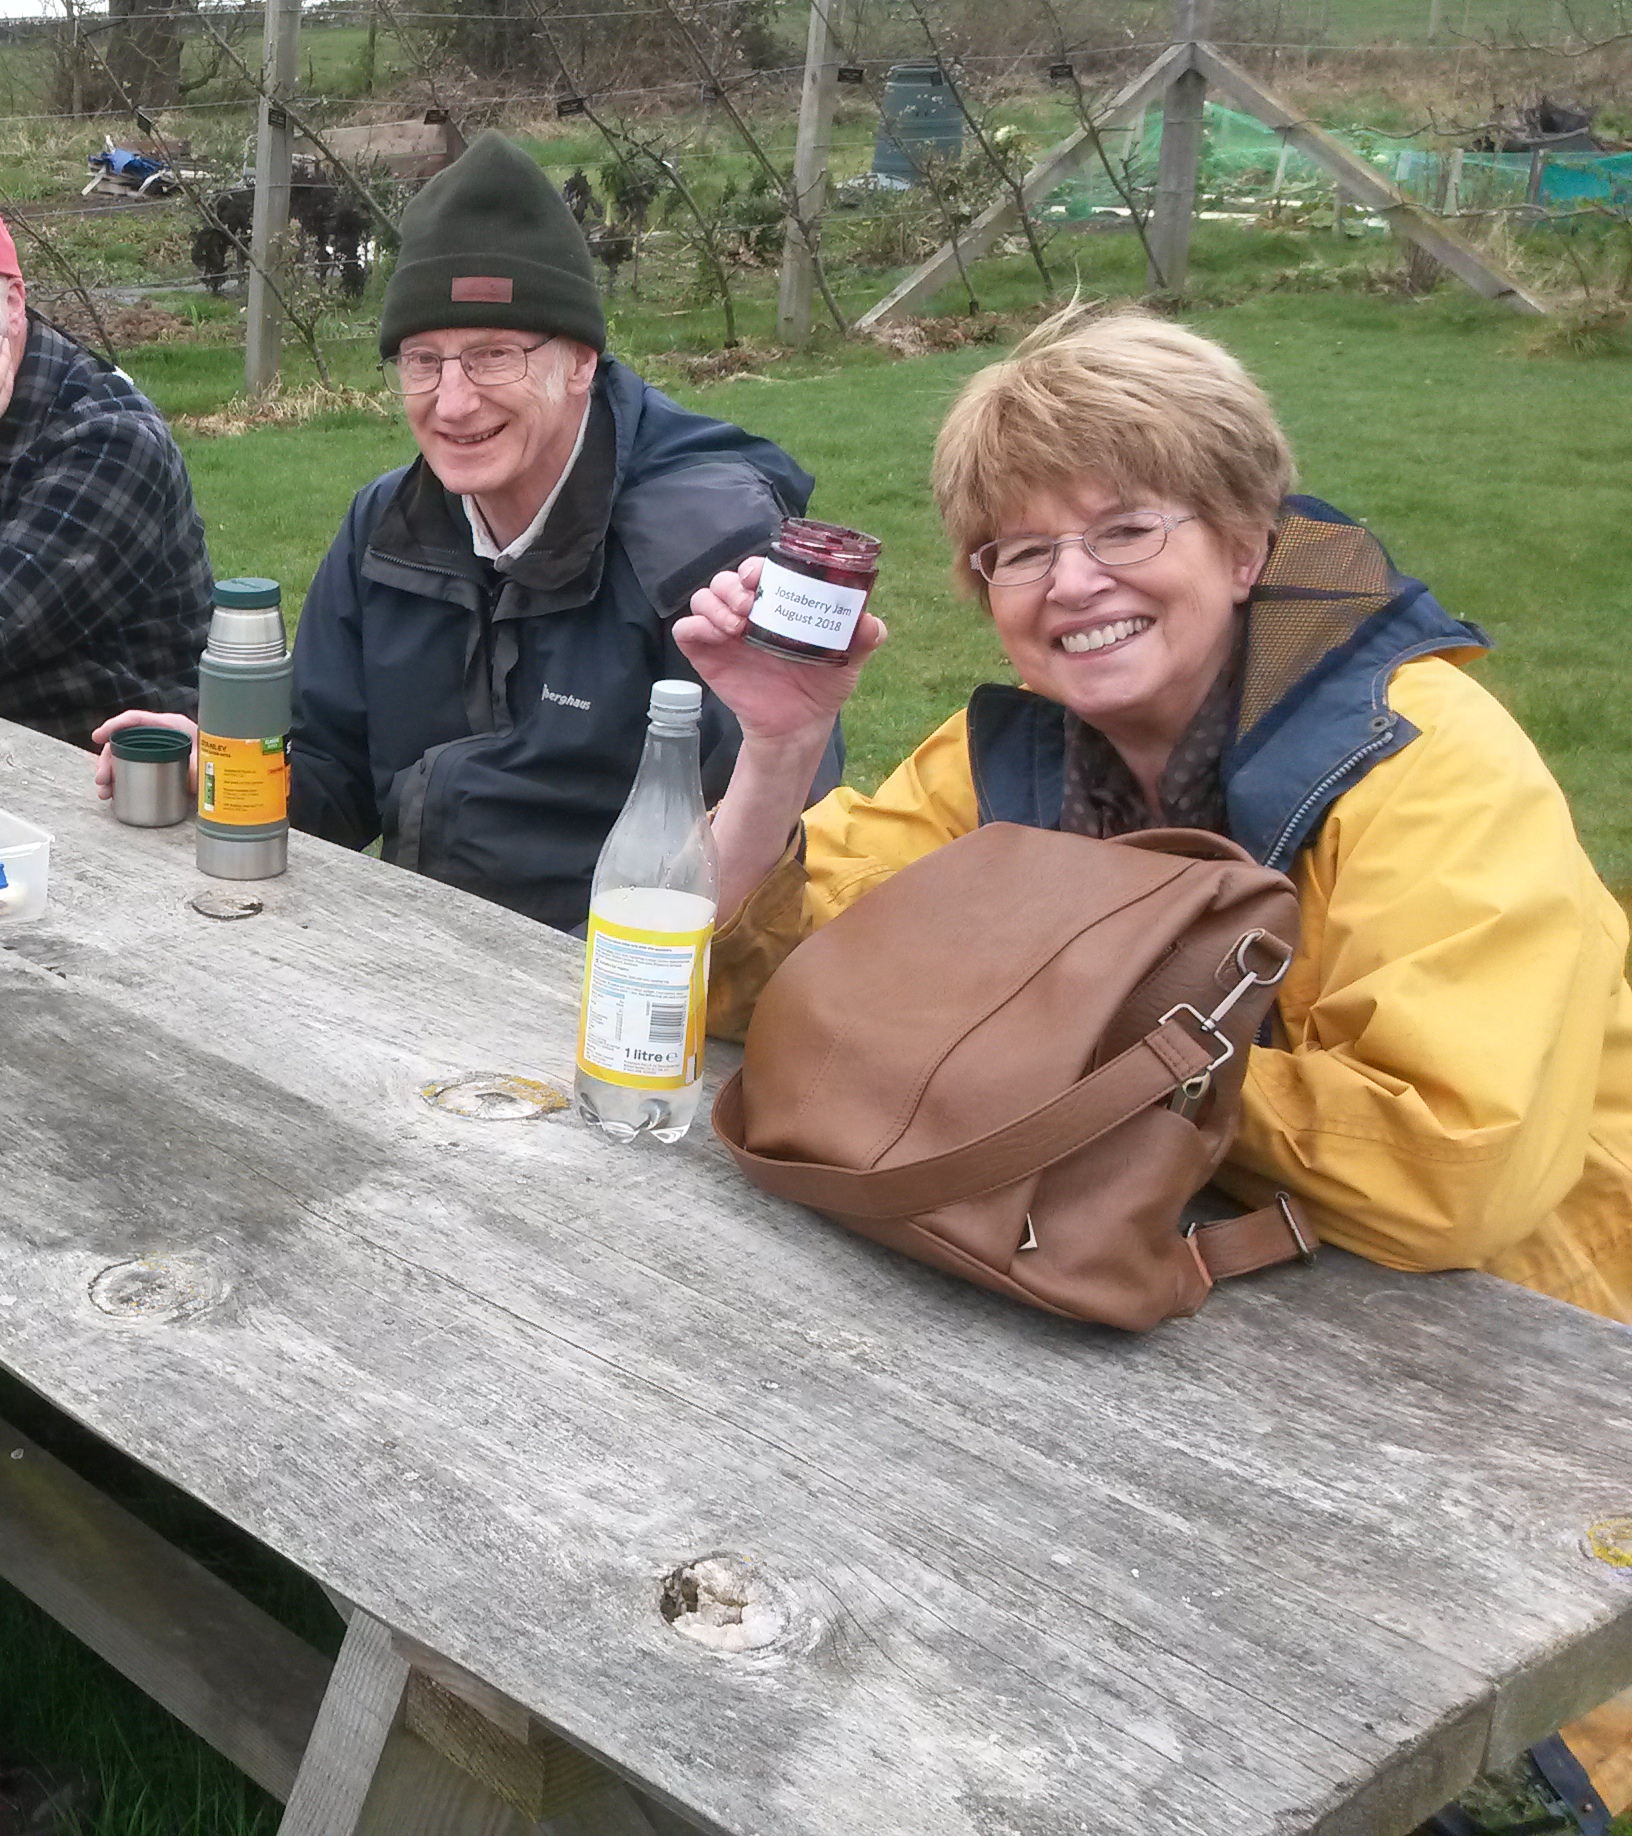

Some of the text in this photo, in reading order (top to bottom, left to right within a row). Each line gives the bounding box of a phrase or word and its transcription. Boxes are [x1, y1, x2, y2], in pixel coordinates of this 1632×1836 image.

[774, 586, 852, 617] Jostaberry Jam
[773, 604, 842, 632] August 2018
[541, 683, 591, 710] berghaus
[624, 1047, 631, 1058] 1
[633, 1048, 663, 1063] litre
